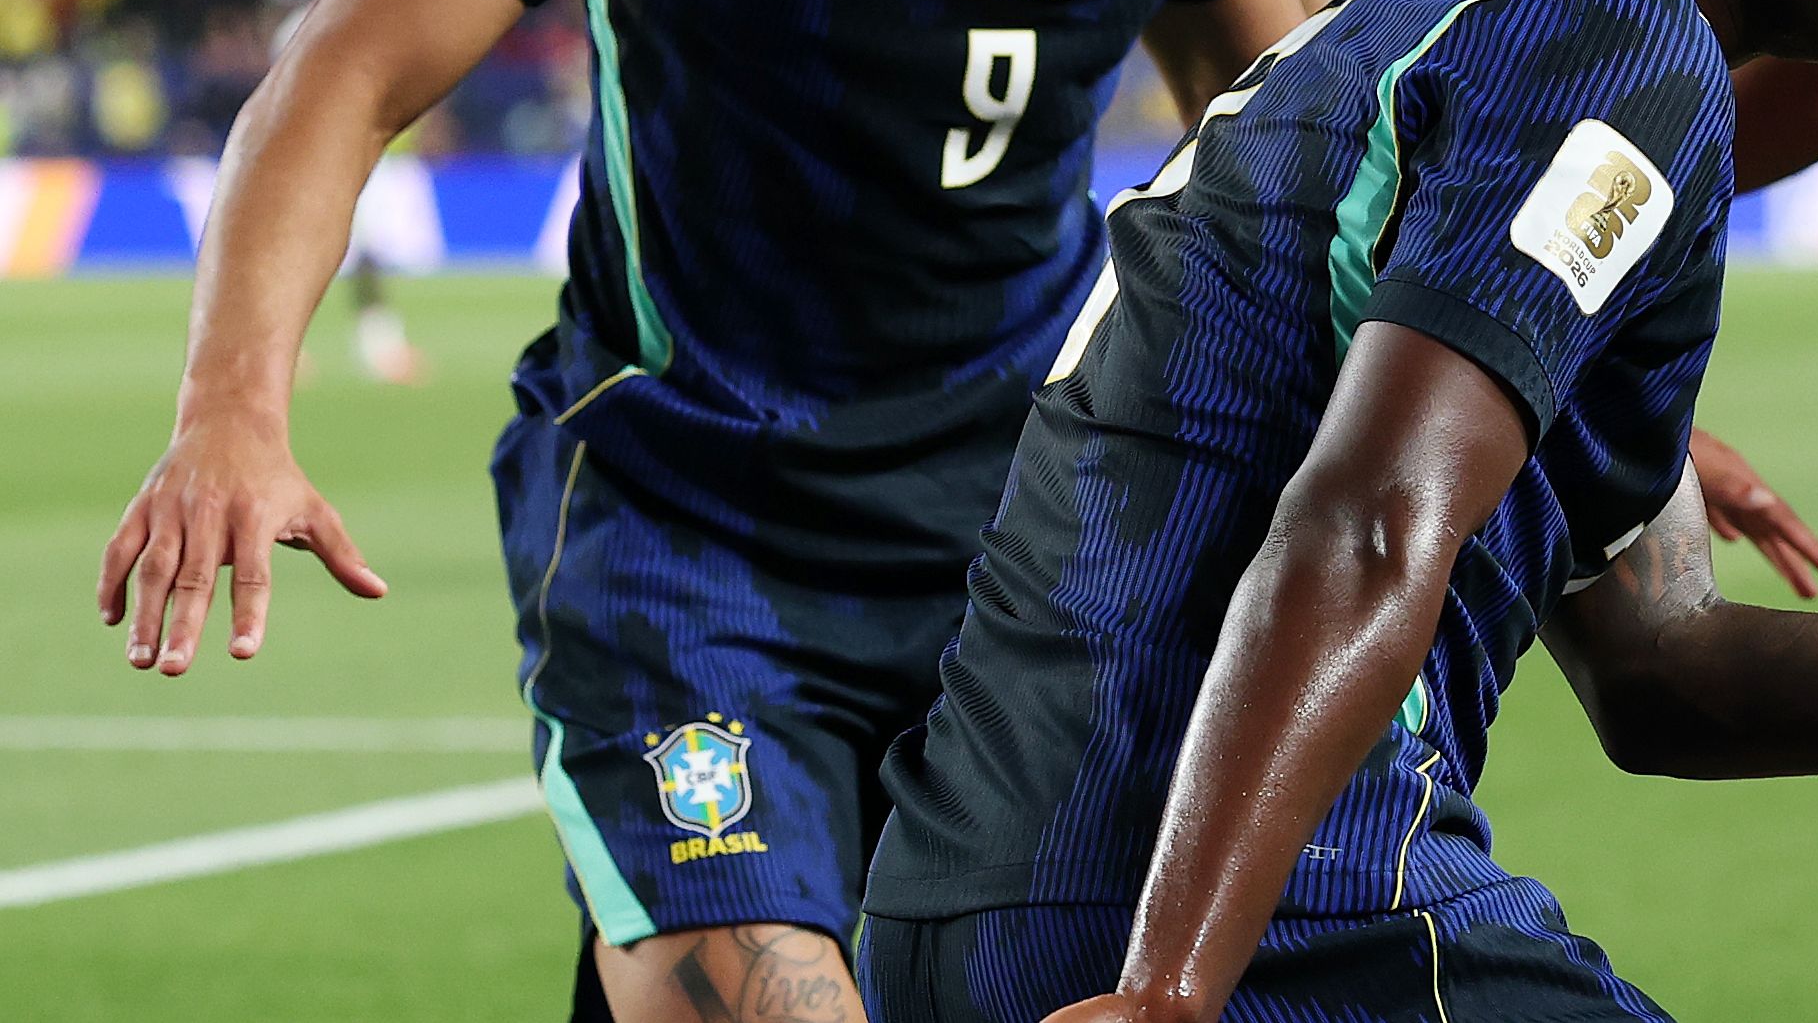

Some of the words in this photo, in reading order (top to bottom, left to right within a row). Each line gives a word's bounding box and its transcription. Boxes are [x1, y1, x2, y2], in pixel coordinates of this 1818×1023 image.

[941, 29, 1037, 190] 9
[1554, 229, 1585, 259] WORLD
[1582, 257, 1596, 274] CUP
[1580, 220, 1602, 249] FIFA
[1543, 240, 1589, 288] 2026
[670, 831, 769, 865] BRASIL
